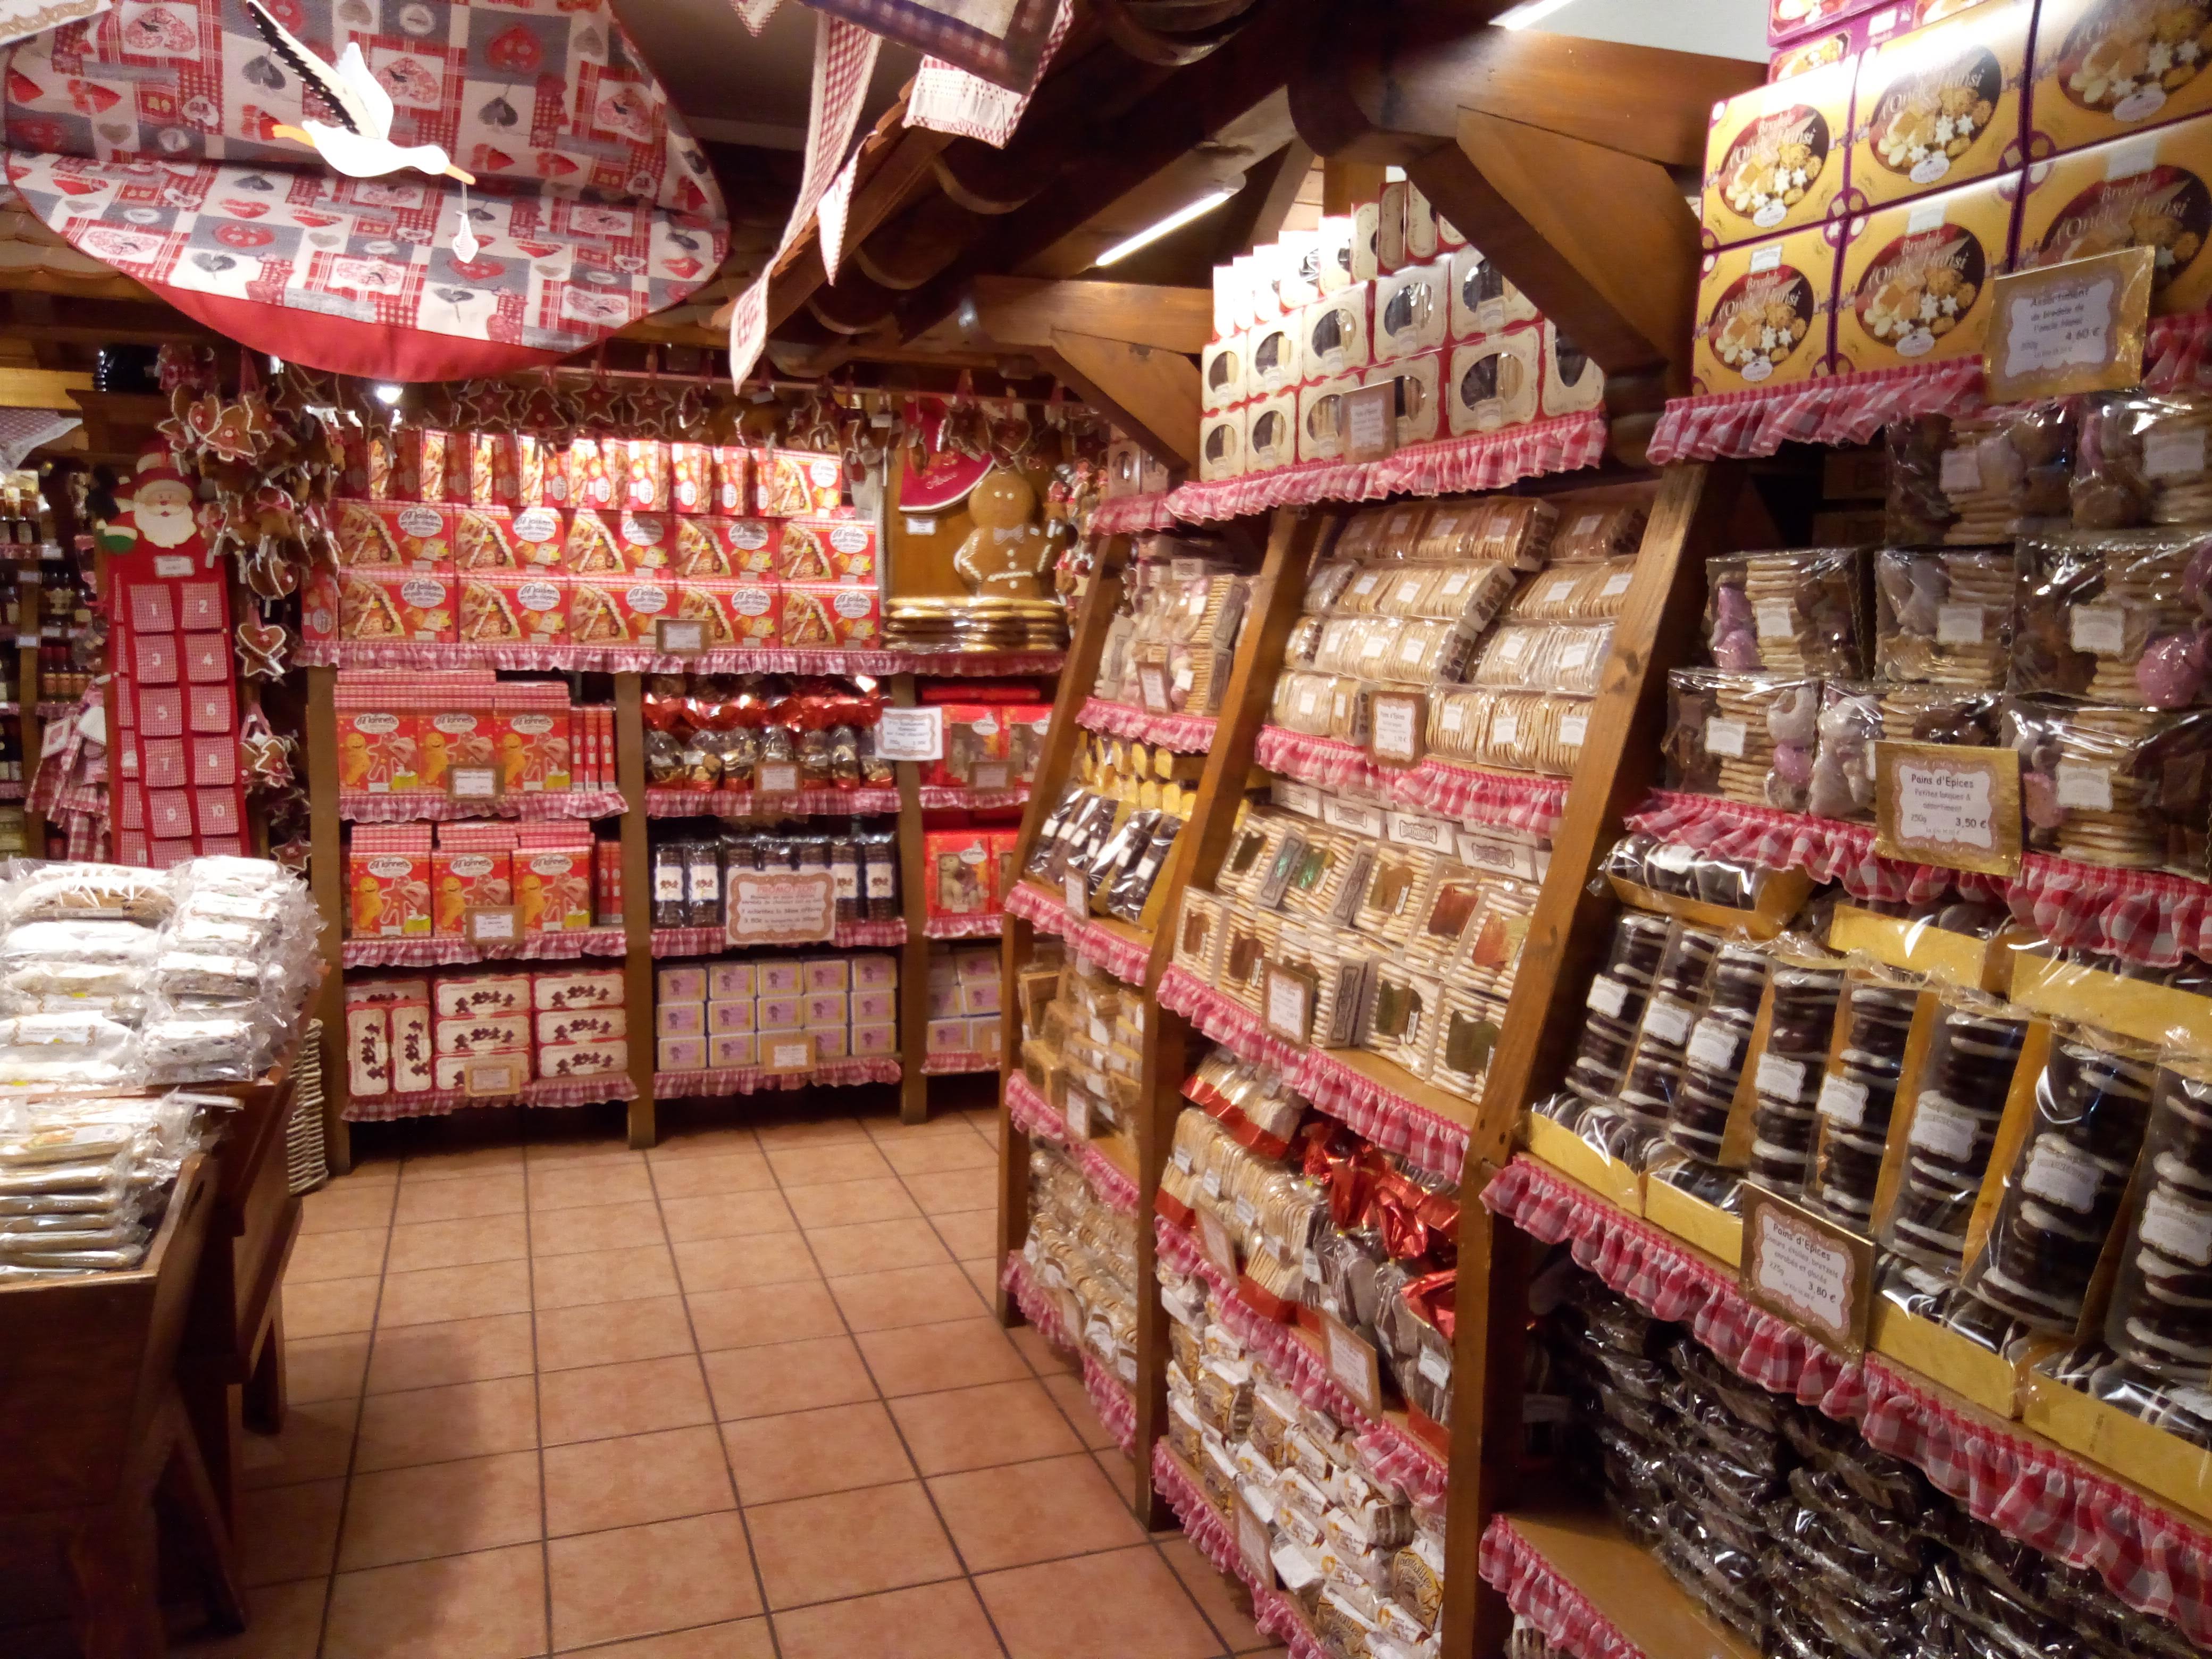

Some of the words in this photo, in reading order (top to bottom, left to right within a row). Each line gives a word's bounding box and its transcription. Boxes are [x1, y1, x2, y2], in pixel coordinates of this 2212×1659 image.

[2031, 287, 2089, 307] Assortiment
[152, 604, 157, 616] 1
[199, 600, 208, 613] 2
[152, 653, 161, 666] 3
[203, 652, 213, 665] 4
[158, 706, 167, 718] 5
[206, 703, 216, 716] 6
[160, 757, 169, 770] 7
[208, 753, 218, 767] 8
[1912, 774, 1932, 785] Pains
[1936, 775, 1974, 789] d'Epices
[166, 808, 177, 821] 9
[212, 805, 225, 817] 10
[1980, 819, 1987, 828] €
[1774, 1224, 1792, 1241] Pains
[1796, 1236, 1830, 1261] d'Epices
